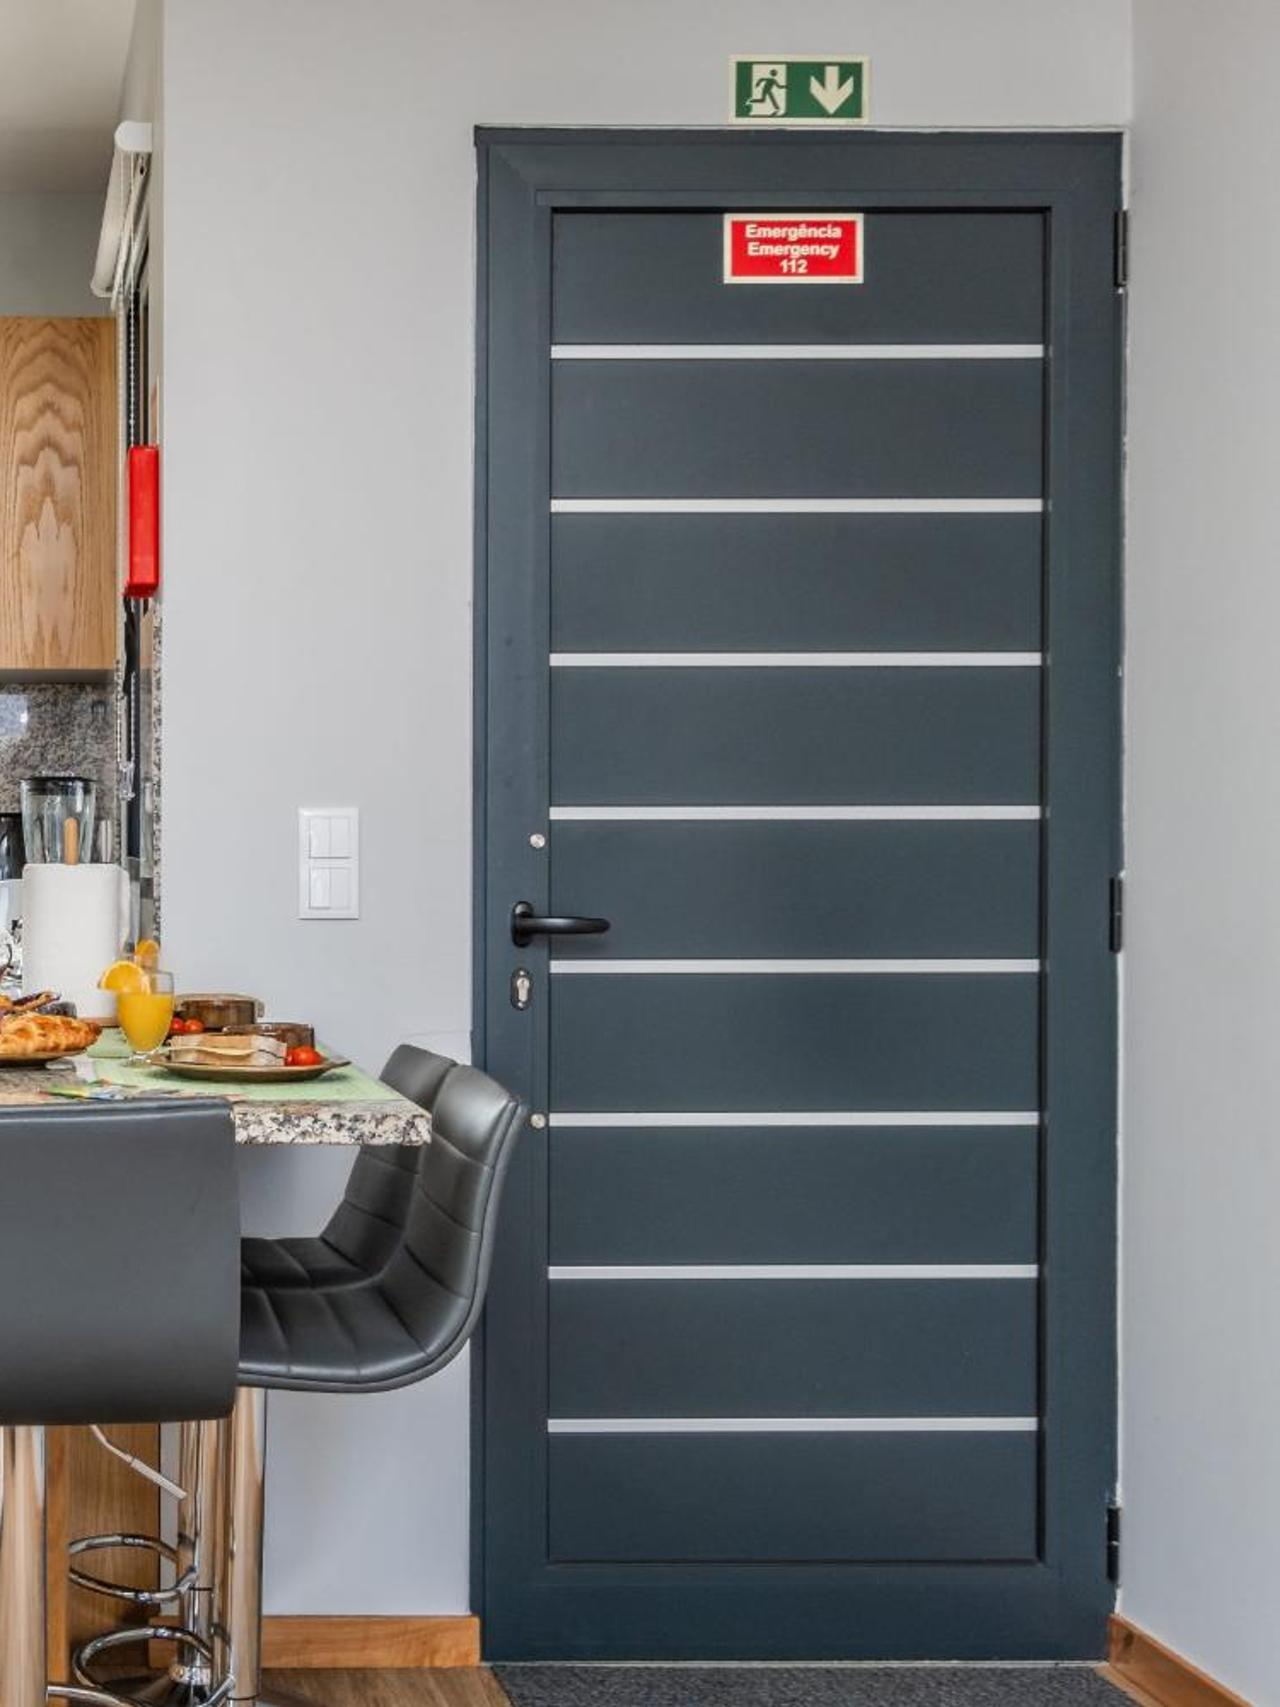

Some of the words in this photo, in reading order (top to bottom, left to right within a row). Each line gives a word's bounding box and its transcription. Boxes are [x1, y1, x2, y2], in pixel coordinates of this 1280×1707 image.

[745, 224, 842, 241] Emergência
[747, 242, 839, 259] Emergency
[780, 259, 808, 273] 112
